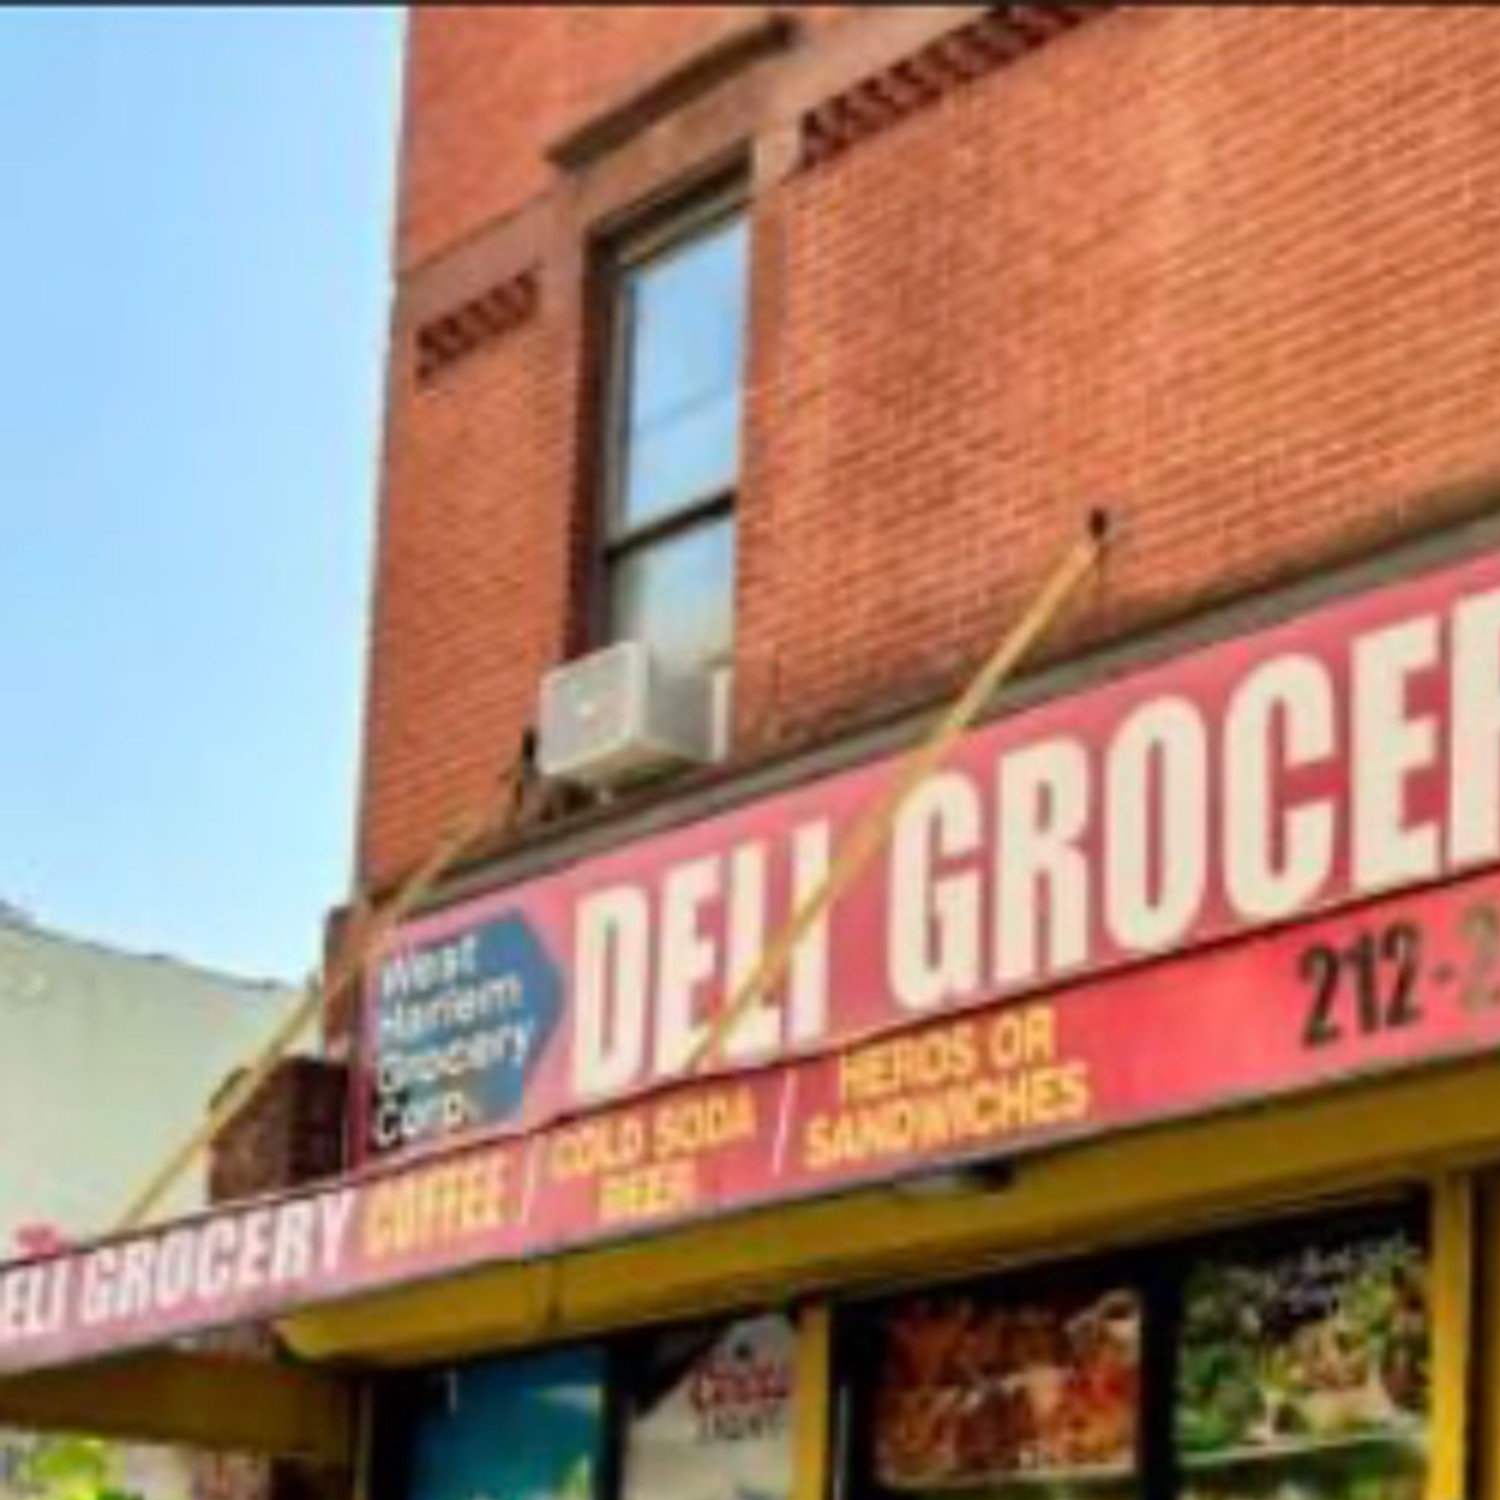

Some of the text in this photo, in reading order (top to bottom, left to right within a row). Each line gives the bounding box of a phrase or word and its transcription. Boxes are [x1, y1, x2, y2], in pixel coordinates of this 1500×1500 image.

[382, 932, 476, 998] West
[569, 818, 829, 1102] DELI
[840, 1003, 1056, 1104] HEROS OR
[551, 1087, 758, 1178] COLD SODA
[804, 1059, 1090, 1172] SANDWICHES
[80, 1187, 357, 1327] GROCERY
